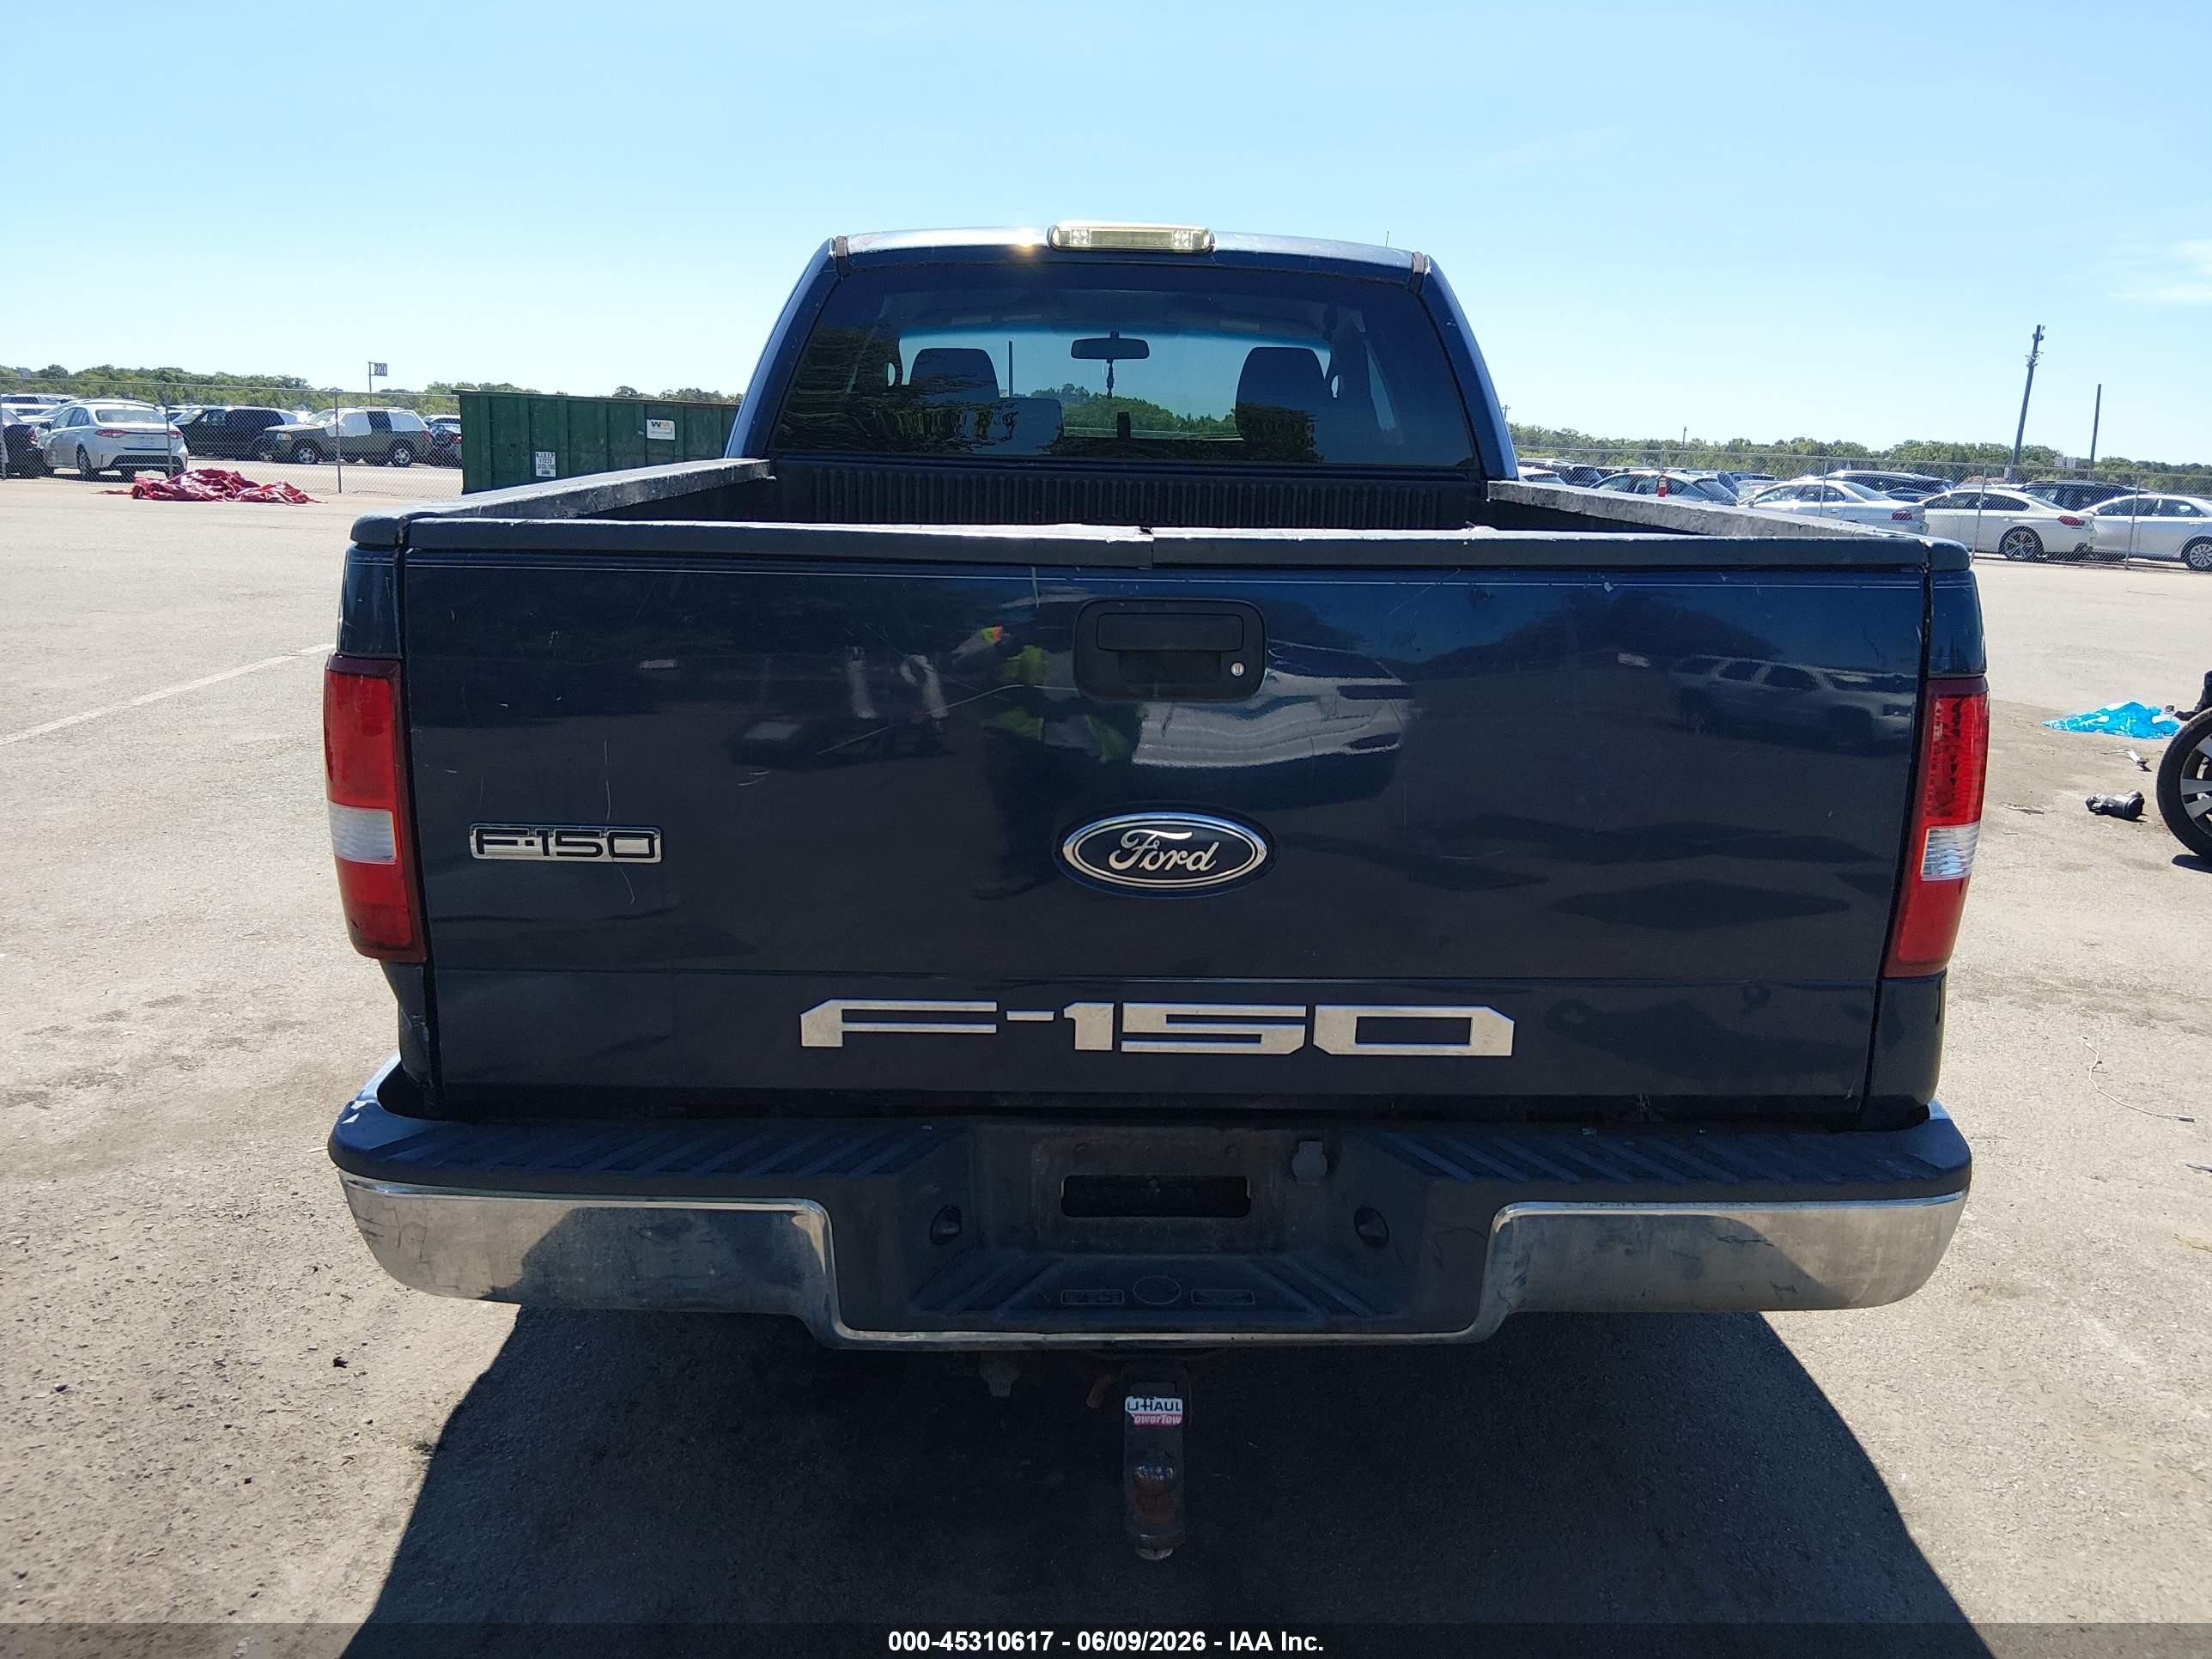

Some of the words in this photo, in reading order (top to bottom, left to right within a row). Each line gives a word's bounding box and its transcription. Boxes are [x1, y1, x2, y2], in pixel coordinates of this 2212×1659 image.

[1109, 829, 1219, 871] Ford
[800, 1000, 1515, 1056] F-150
[1127, 1400, 1182, 1412] U-HAUL
[1133, 1414, 1182, 1424] owerTow
